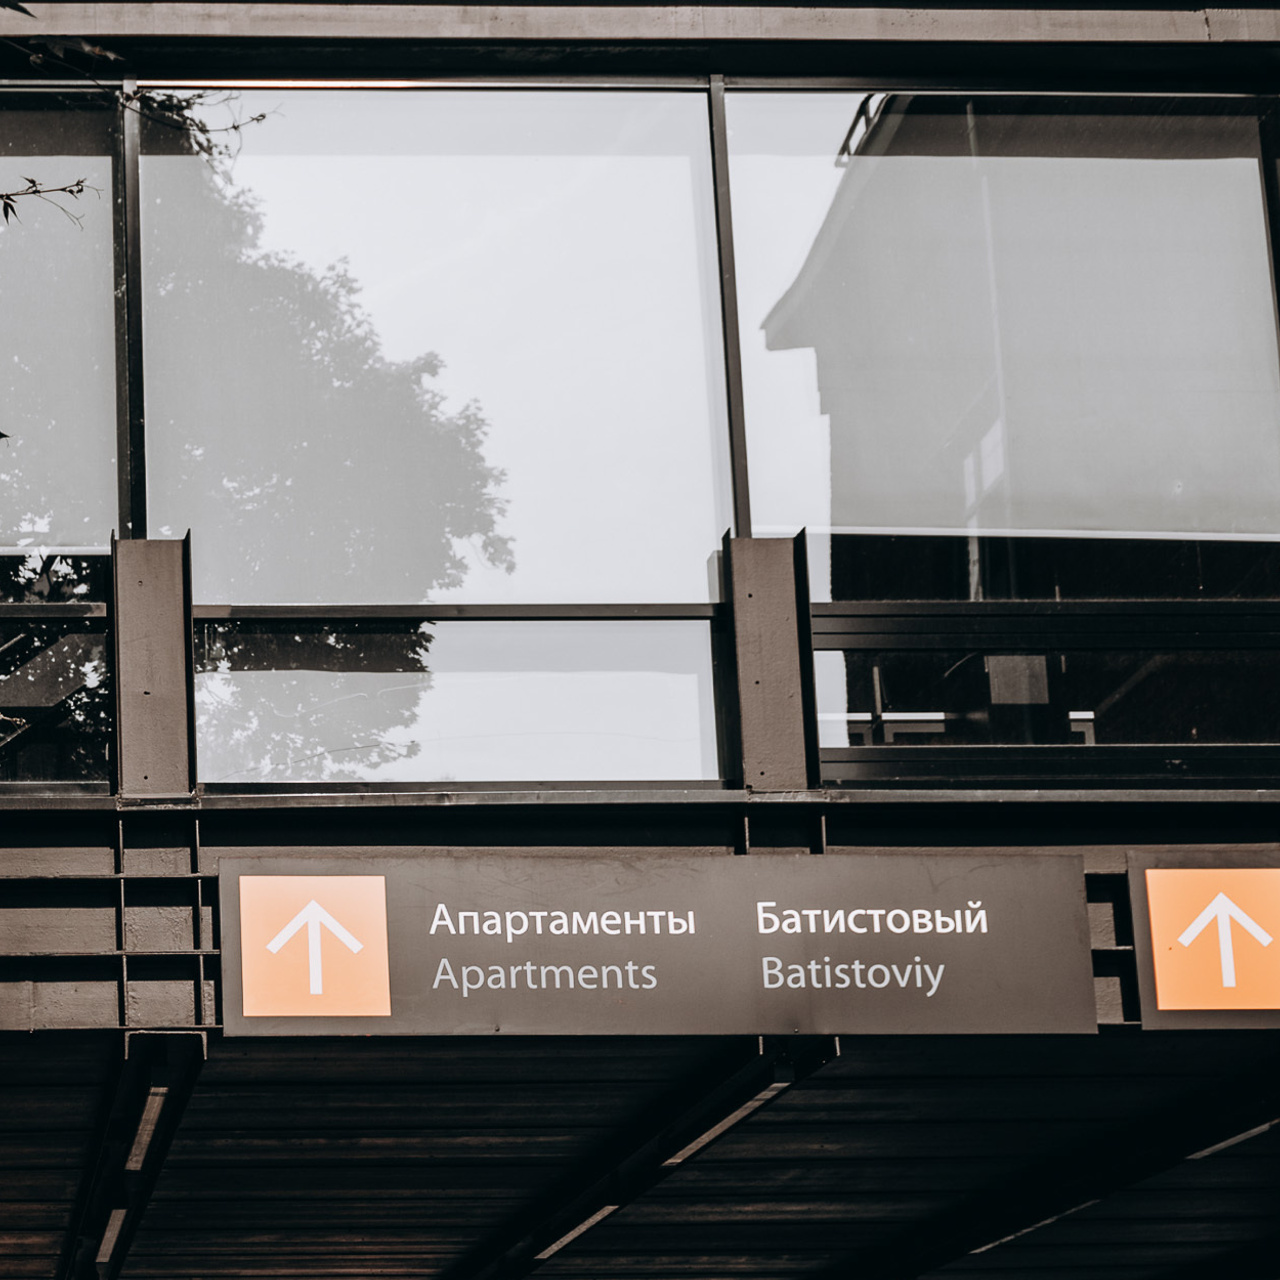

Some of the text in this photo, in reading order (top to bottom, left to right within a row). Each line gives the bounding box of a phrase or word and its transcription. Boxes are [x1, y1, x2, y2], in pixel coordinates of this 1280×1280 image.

[429, 904, 696, 943] Апартаменты
[756, 900, 989, 935] Батистовый
[432, 957, 658, 998] Apartments
[761, 956, 946, 998] Batistoviy
